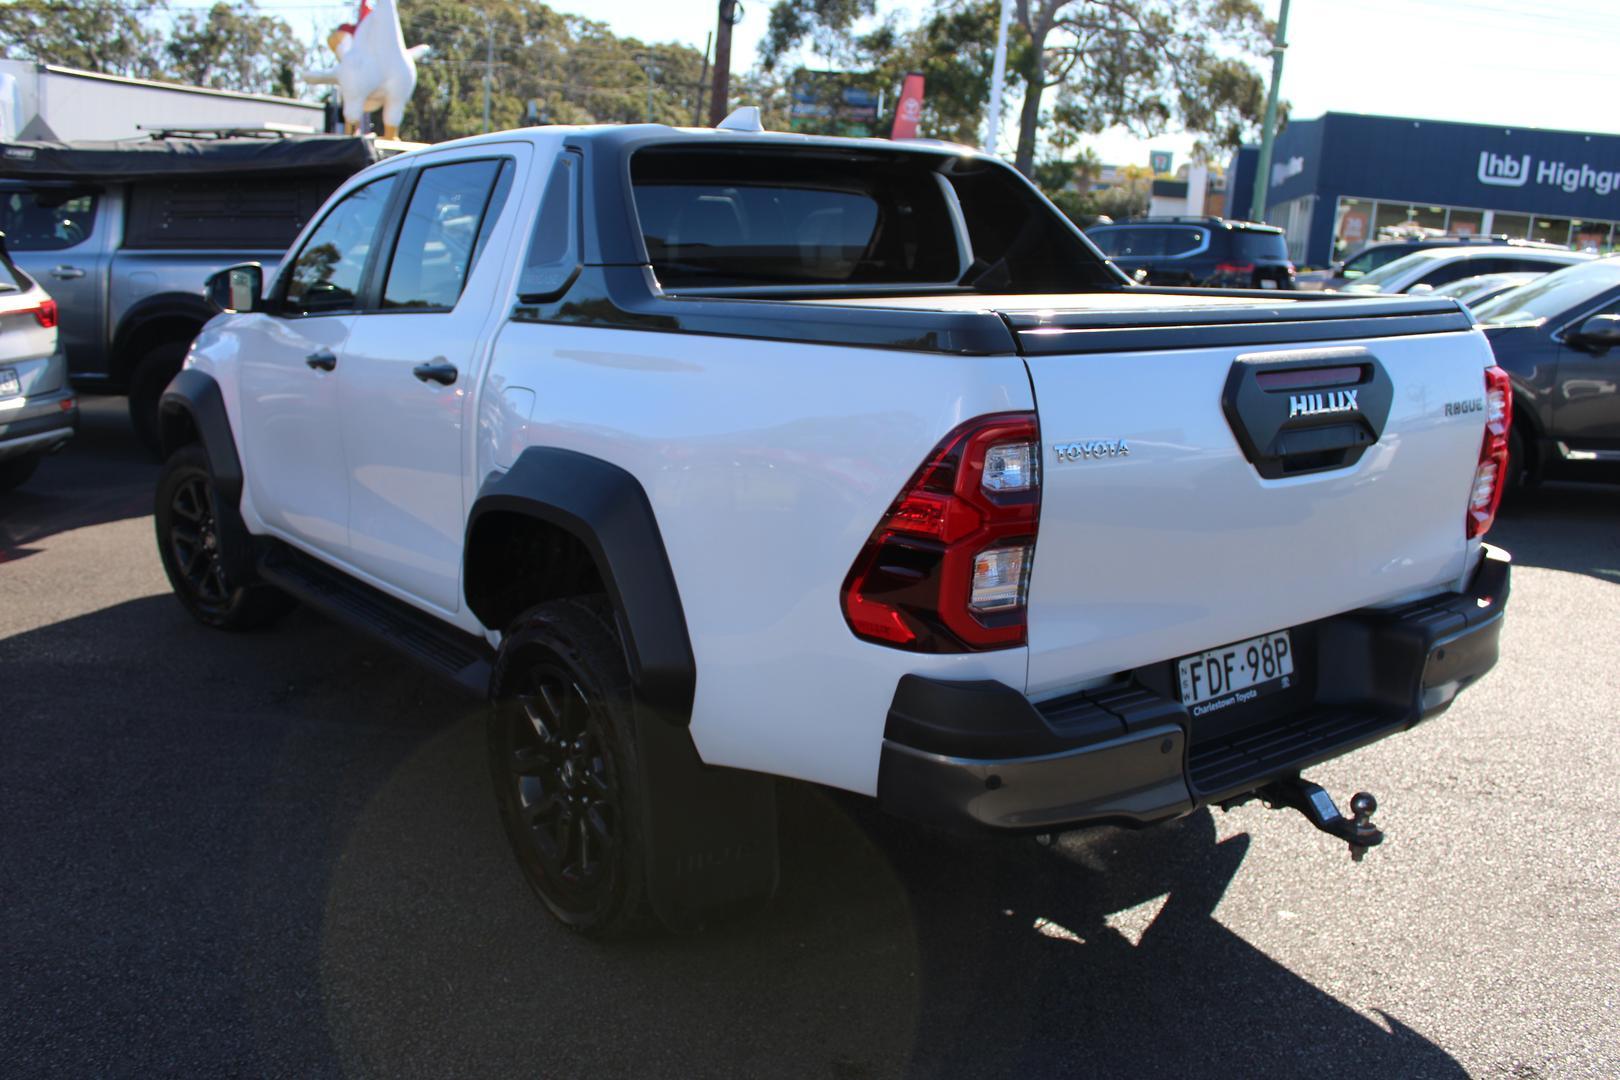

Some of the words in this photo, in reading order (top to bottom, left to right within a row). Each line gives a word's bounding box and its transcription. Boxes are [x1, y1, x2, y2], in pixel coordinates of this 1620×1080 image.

[1289, 389, 1358, 418] HILUX
[1444, 398, 1483, 417] ROGUE
[1053, 439, 1129, 463] TOYOTA
[1193, 696, 1236, 717] Charlestown
[1235, 689, 1258, 703] Toyota
